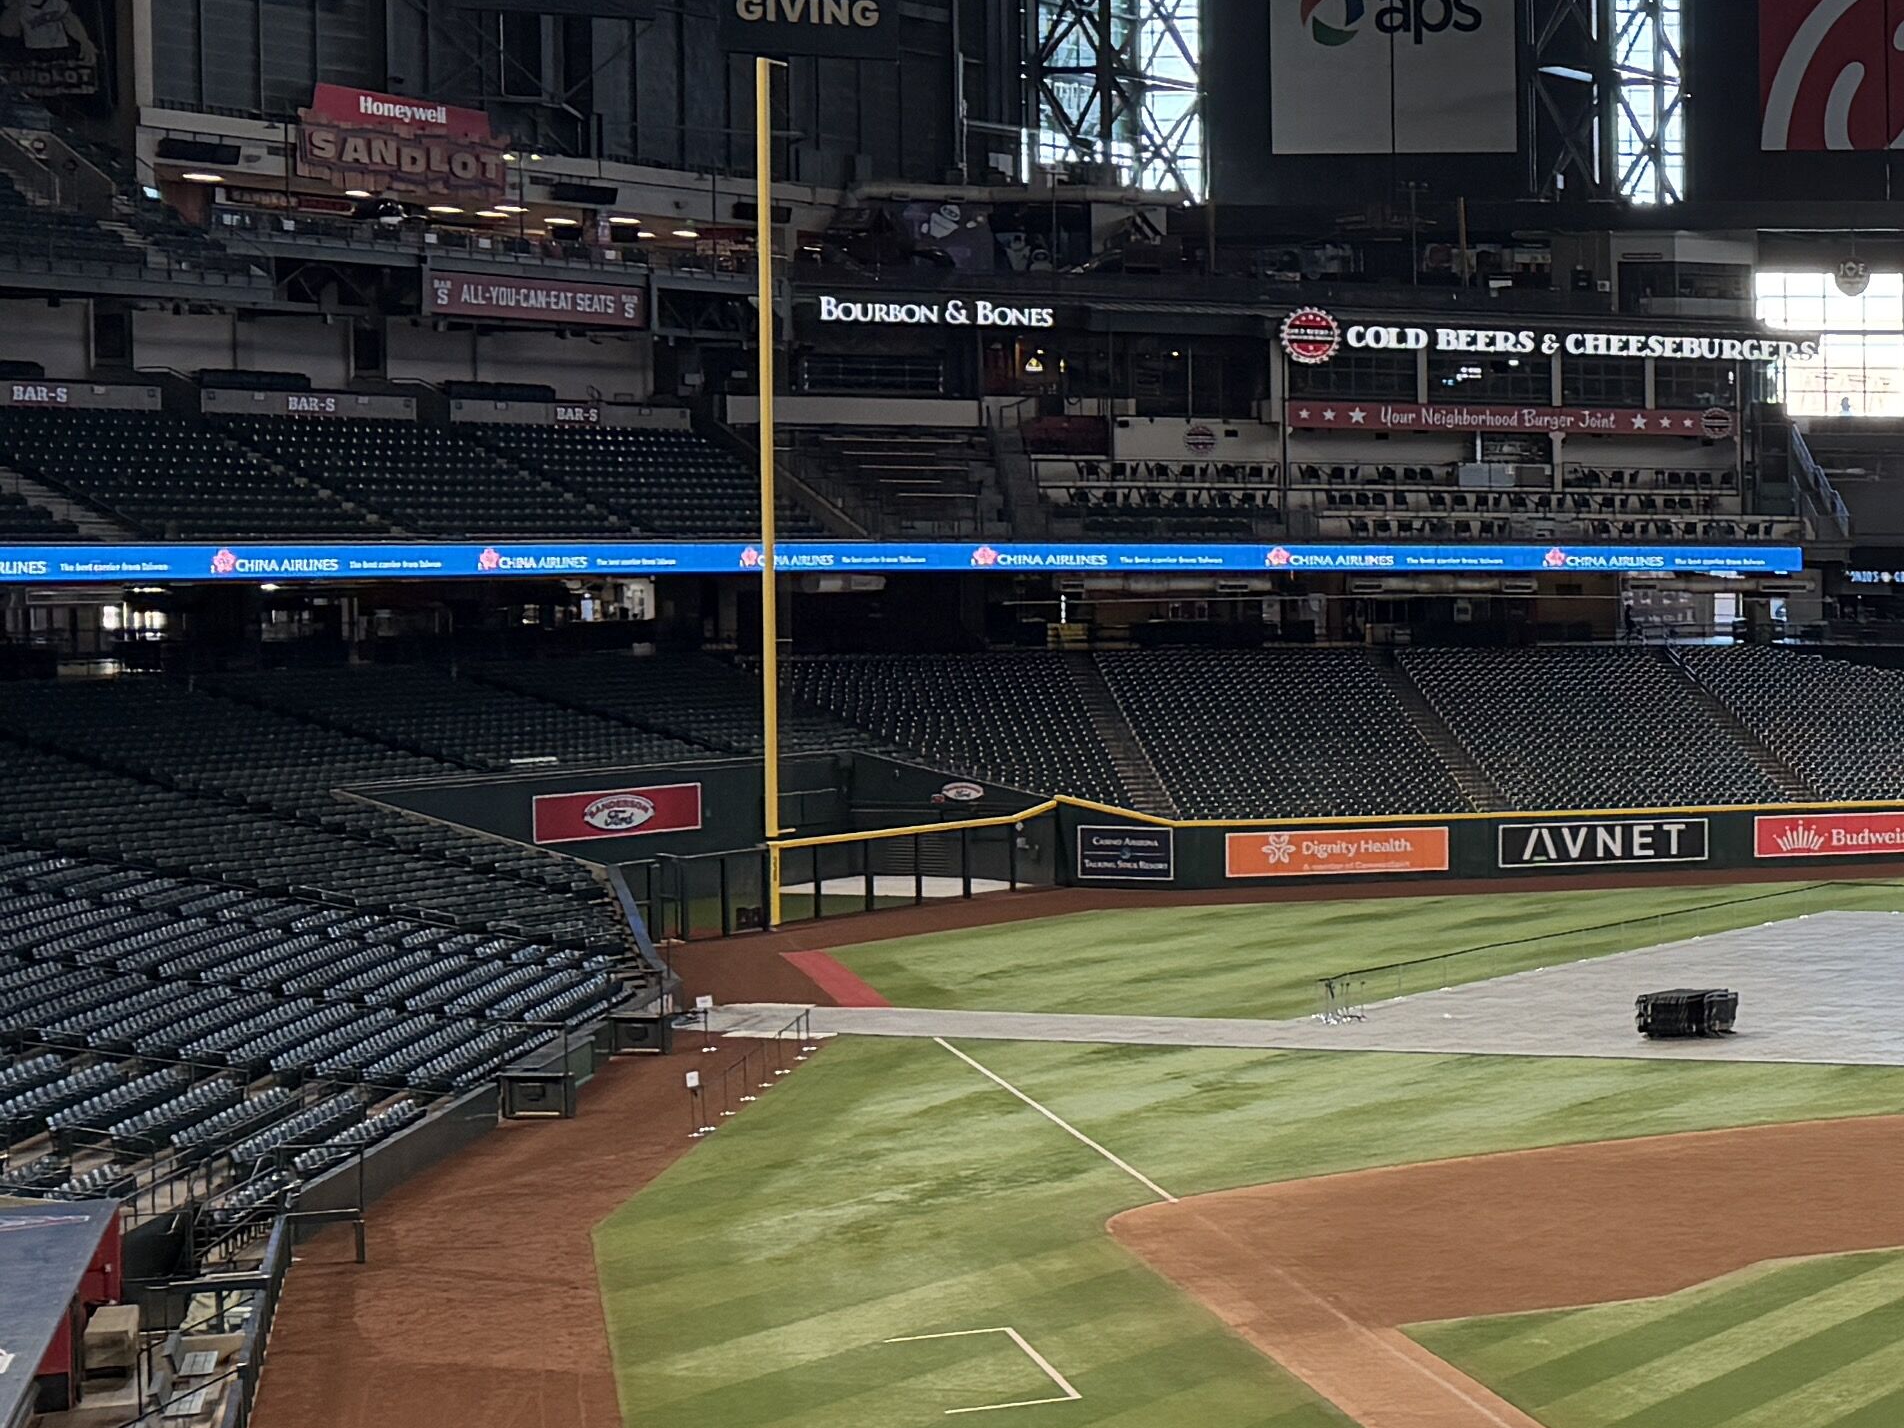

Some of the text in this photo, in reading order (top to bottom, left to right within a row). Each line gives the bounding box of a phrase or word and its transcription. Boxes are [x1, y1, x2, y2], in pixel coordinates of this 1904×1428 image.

[359, 95, 447, 124] Honeywell
[310, 129, 502, 180] SANDLOT
[461, 284, 615, 313] ALL-YOU-CAN-EAT SEATS
[945, 300, 970, 324] &
[1347, 326, 1428, 349] COLD
[1436, 329, 1534, 353] BEERS
[1541, 334, 1559, 355] &
[1566, 333, 1820, 362] CHEESEBURGERS
[12, 385, 68, 403] BAR-S
[288, 396, 336, 412] BAR-S
[556, 407, 598, 422] BAR-S
[1381, 407, 1615, 431] Your Neighborhood Burger Joint
[604, 809, 635, 827] Ford
[1302, 838, 1412, 859] Dignity Health
[1522, 824, 1686, 861] AVNET
